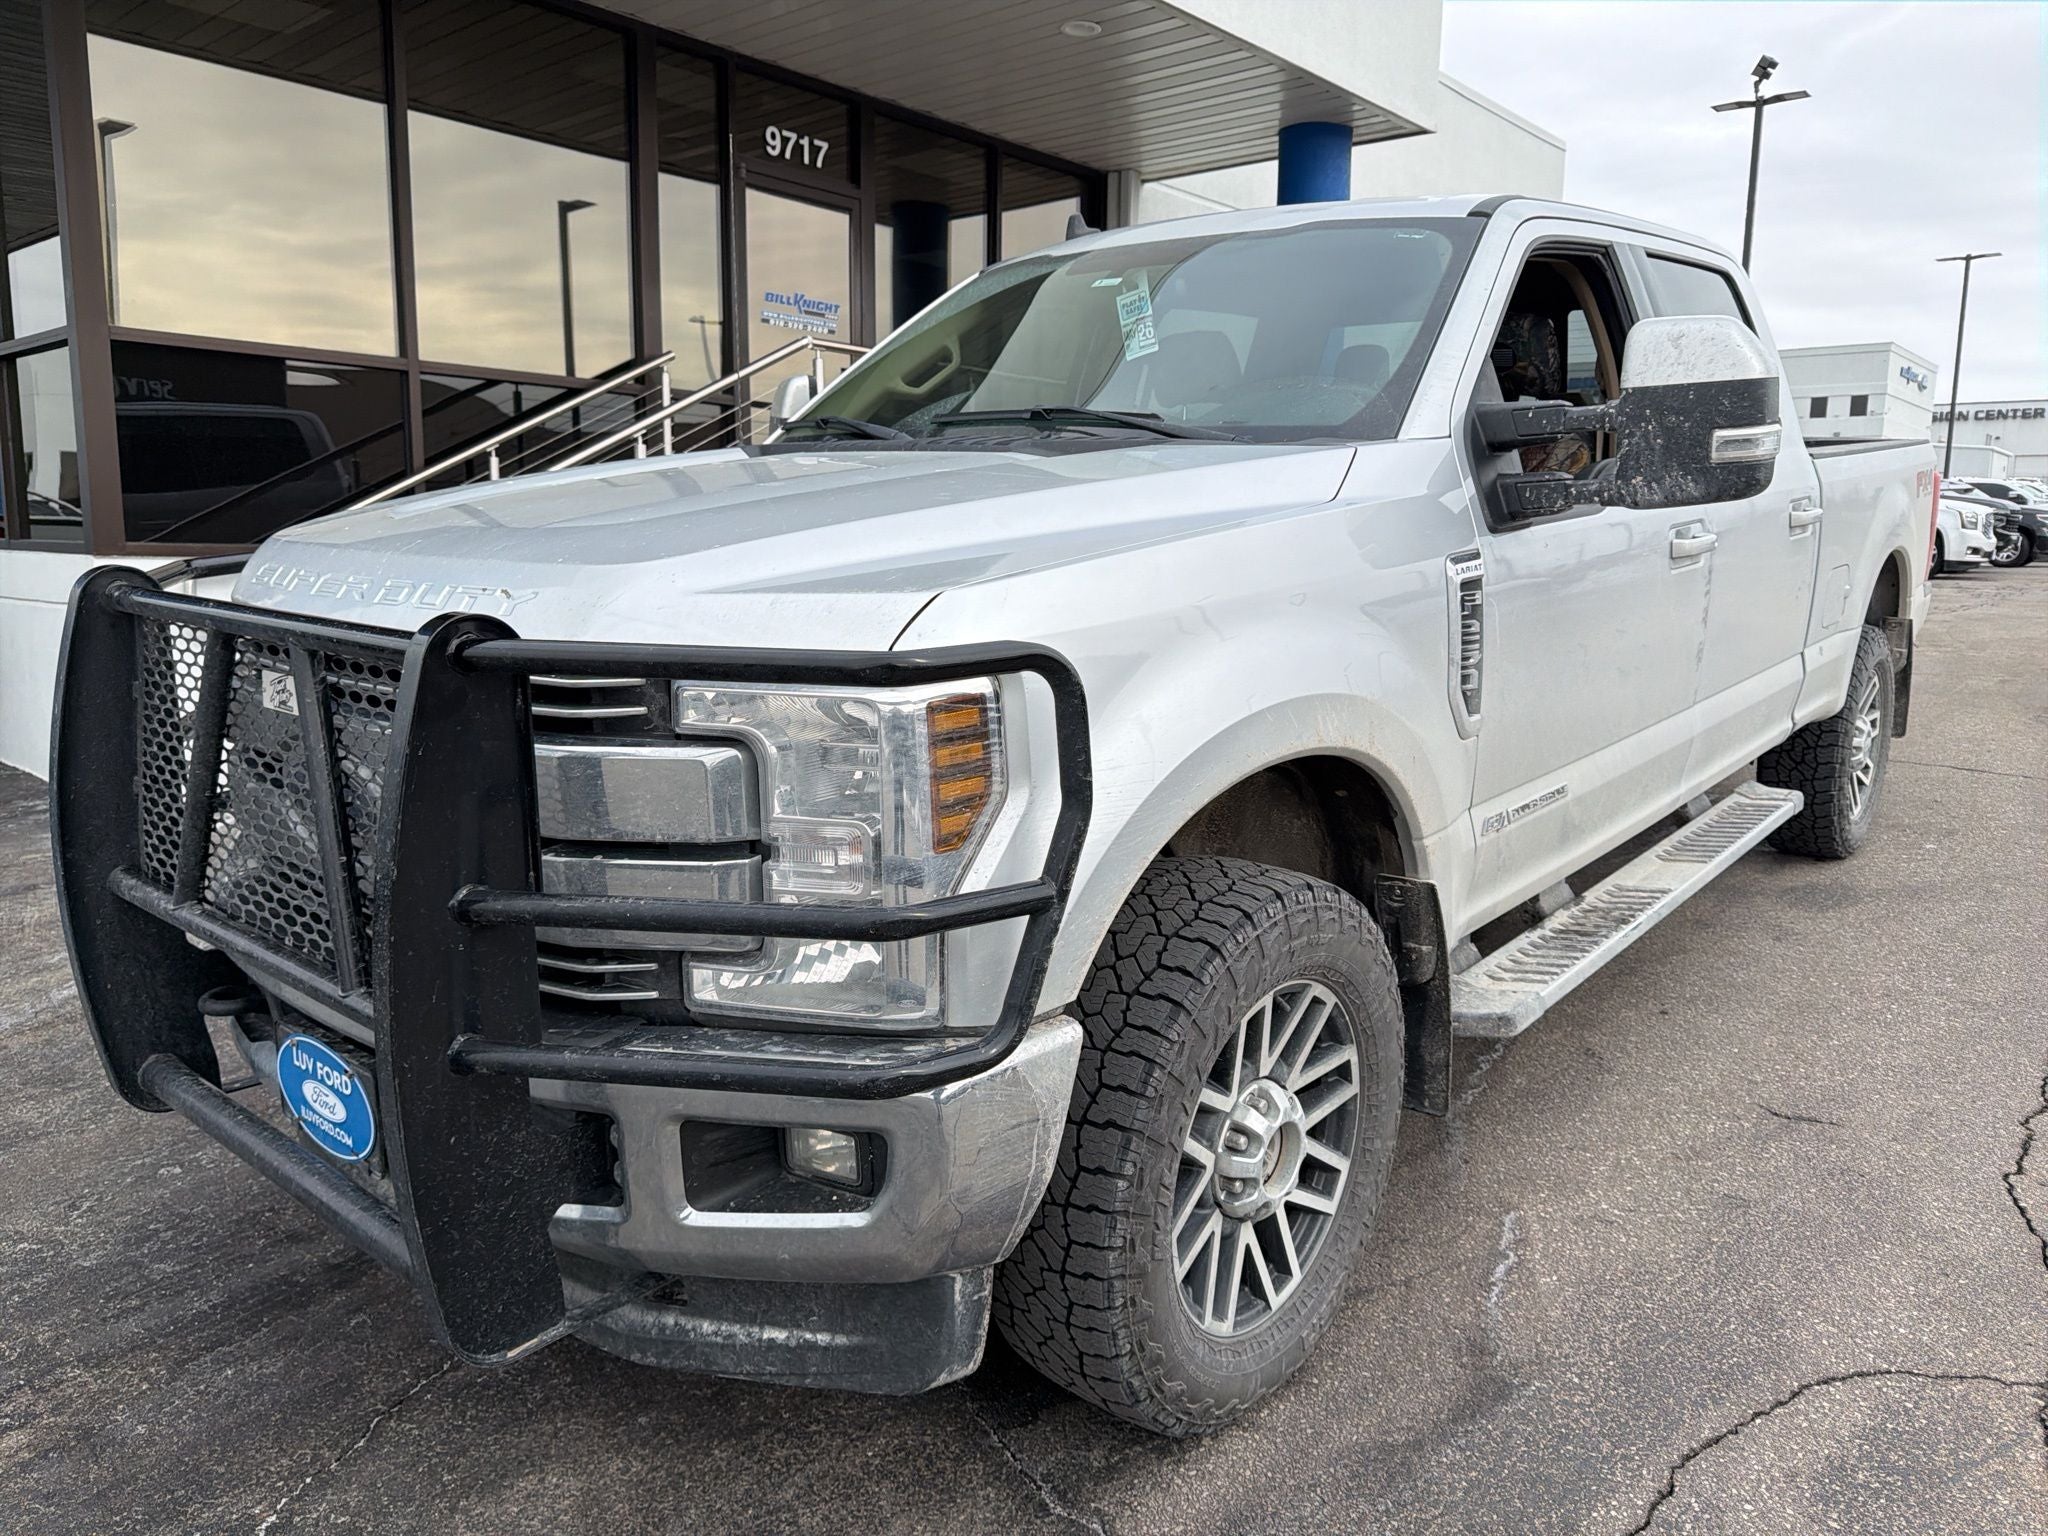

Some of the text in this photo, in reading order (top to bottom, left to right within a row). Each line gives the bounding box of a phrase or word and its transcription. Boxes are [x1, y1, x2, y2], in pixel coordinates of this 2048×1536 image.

[765, 125, 829, 169] 9717
[1138, 321, 1154, 341] 26
[1974, 407, 2046, 422] CENTER
[1455, 563, 1483, 576] LARIAT
[252, 563, 539, 616] SUPER DUTY
[292, 1046, 352, 1096] LUV FORD
[311, 1085, 338, 1118] Ford
